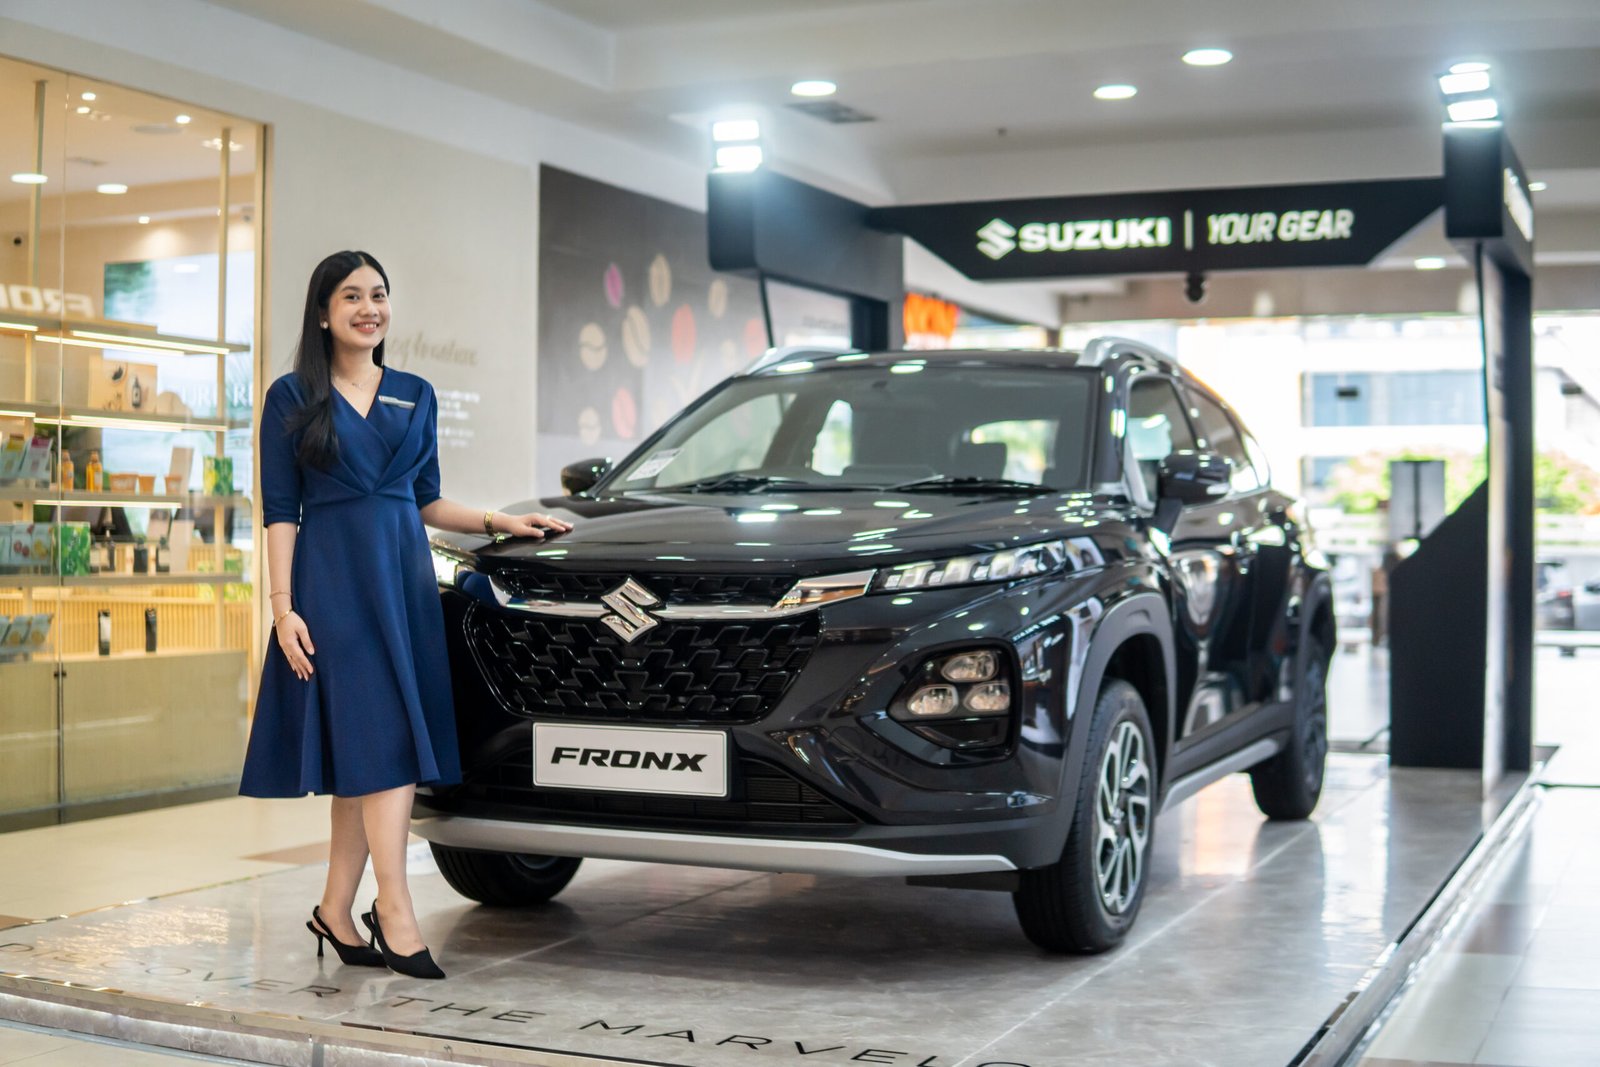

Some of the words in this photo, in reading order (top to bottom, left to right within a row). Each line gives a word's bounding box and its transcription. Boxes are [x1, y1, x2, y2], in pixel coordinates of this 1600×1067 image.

[1018, 216, 1172, 253] SUZUKI
[1207, 211, 1277, 245] YOUR
[1277, 208, 1355, 242] GEAR
[550, 746, 708, 773] FRONX
[391, 995, 547, 1024] THE
